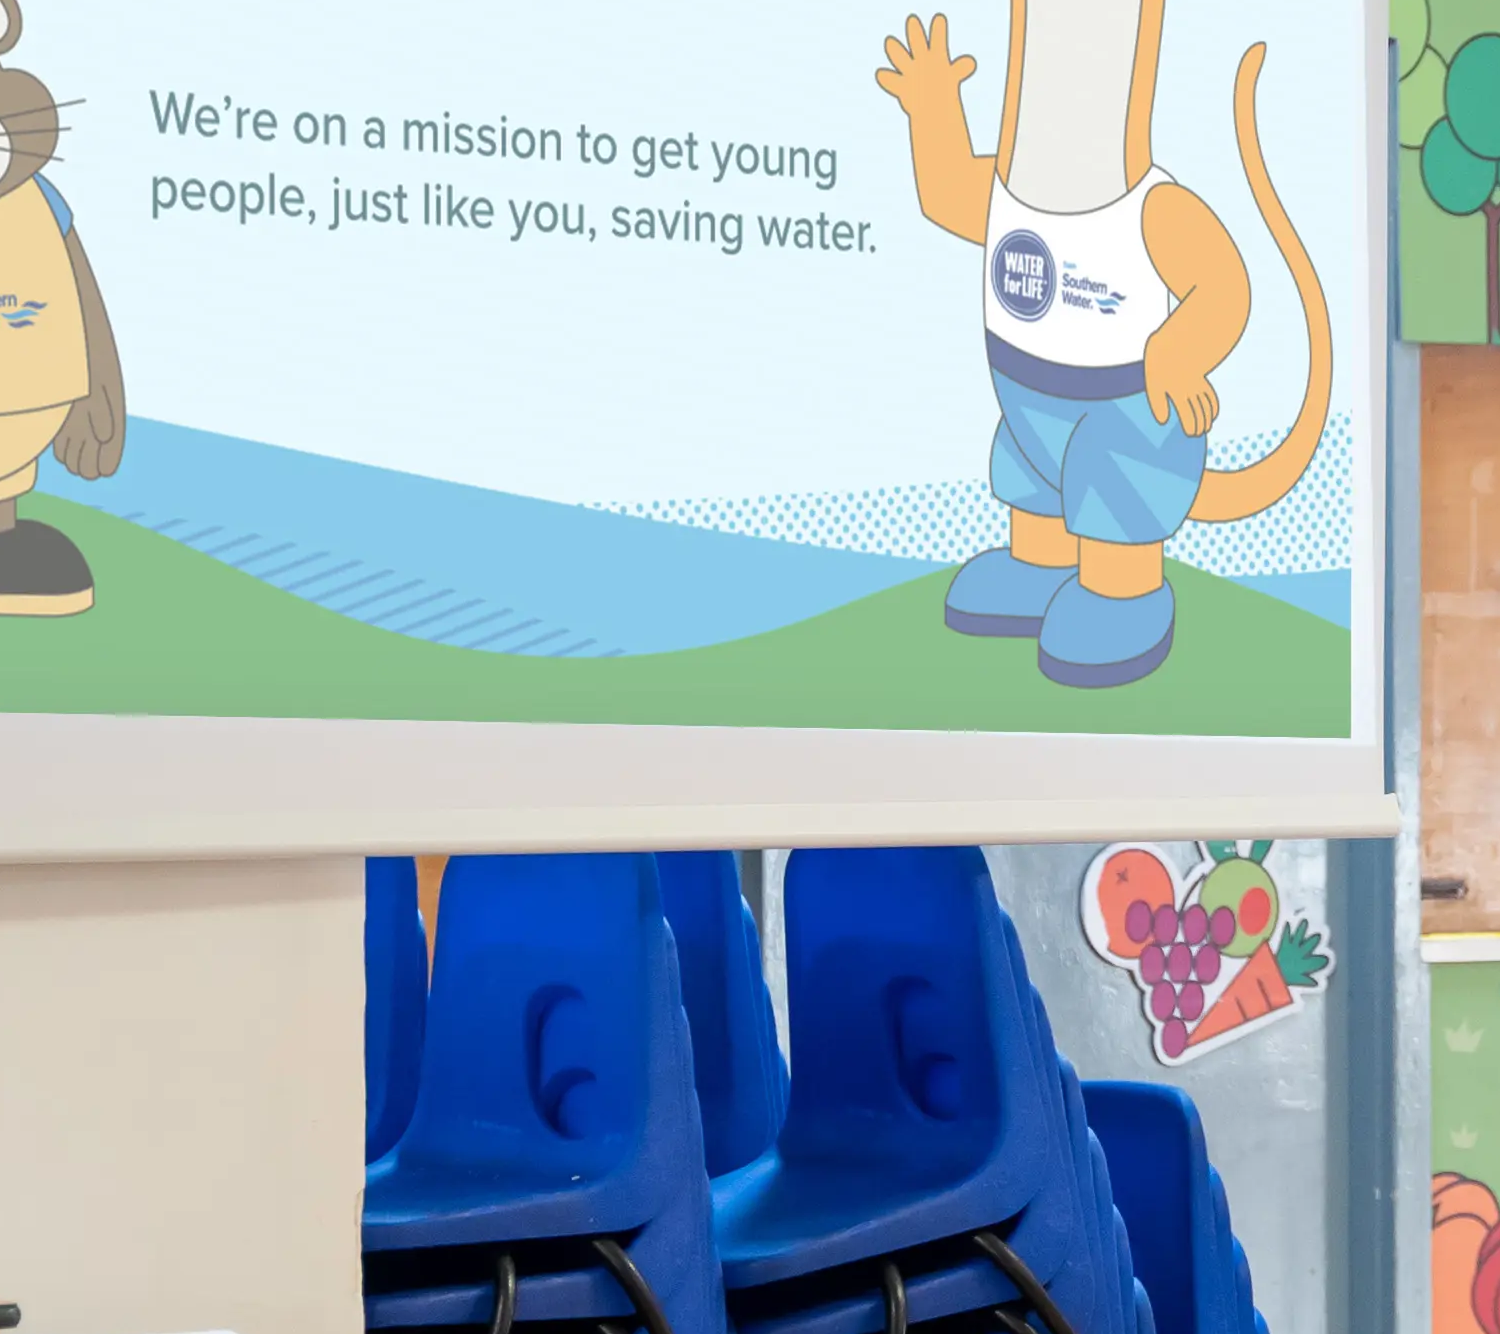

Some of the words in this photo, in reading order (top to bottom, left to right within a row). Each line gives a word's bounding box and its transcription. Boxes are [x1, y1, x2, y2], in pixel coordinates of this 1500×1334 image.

[149, 89, 278, 142] We're
[293, 111, 346, 147] on
[363, 116, 386, 150] a
[403, 110, 562, 162] mission
[576, 124, 618, 165] to
[632, 131, 700, 179] get
[710, 140, 837, 191] young
[152, 172, 317, 225] people,
[328, 176, 409, 231] just
[423, 182, 495, 229] like
[508, 199, 597, 243] you,
[611, 199, 743, 256] saving
[757, 211, 877, 255] water.
[1004, 251, 1044, 278] WATER
[1004, 273, 1021, 295] for
[1062, 273, 1108, 295] Southern
